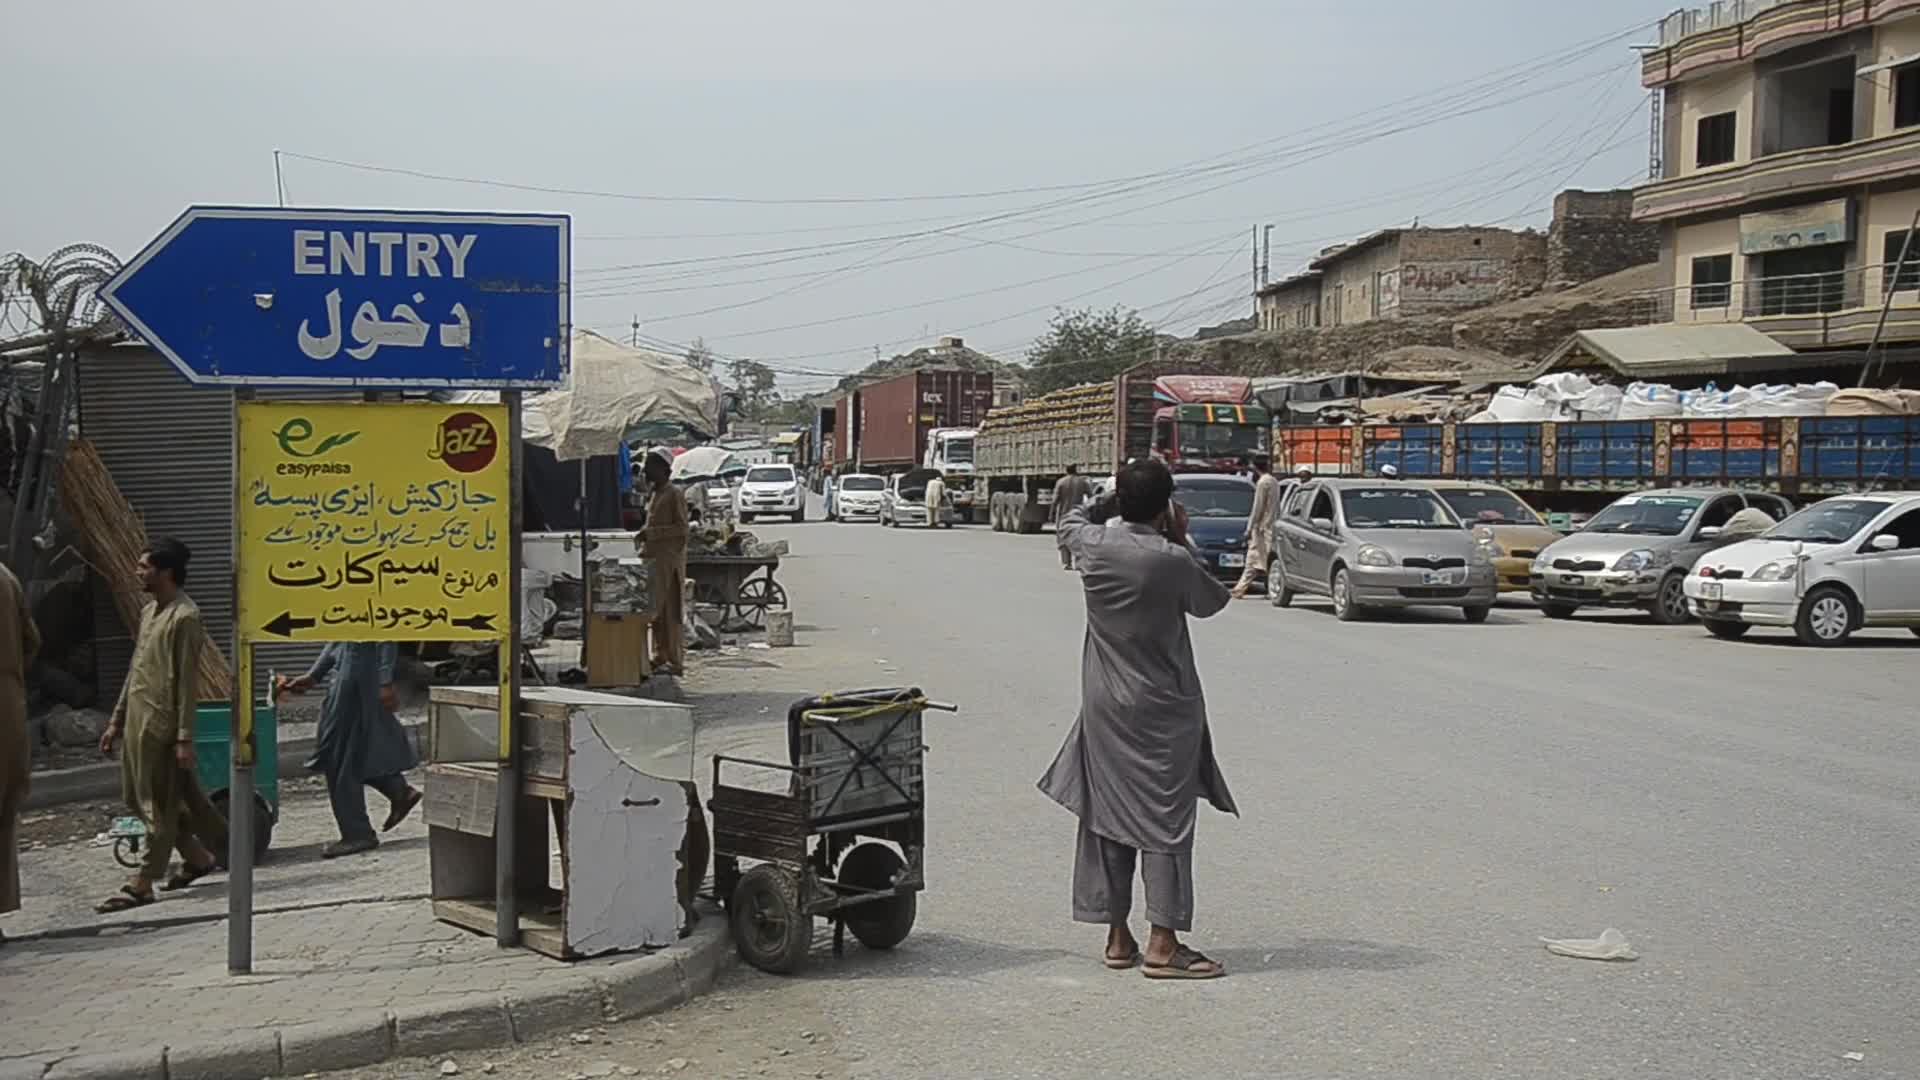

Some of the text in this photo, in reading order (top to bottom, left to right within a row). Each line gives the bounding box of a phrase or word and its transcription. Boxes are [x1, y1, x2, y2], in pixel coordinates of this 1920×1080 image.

[292, 229, 477, 278] ENTRY
[297, 288, 470, 360] دخول
[427, 422, 493, 460] Jazz
[275, 462, 352, 479] easypaisa
[473, 516, 497, 551] بل
[267, 549, 386, 590] کارت
[377, 555, 440, 597] سیم
[374, 606, 449, 630] موجود
